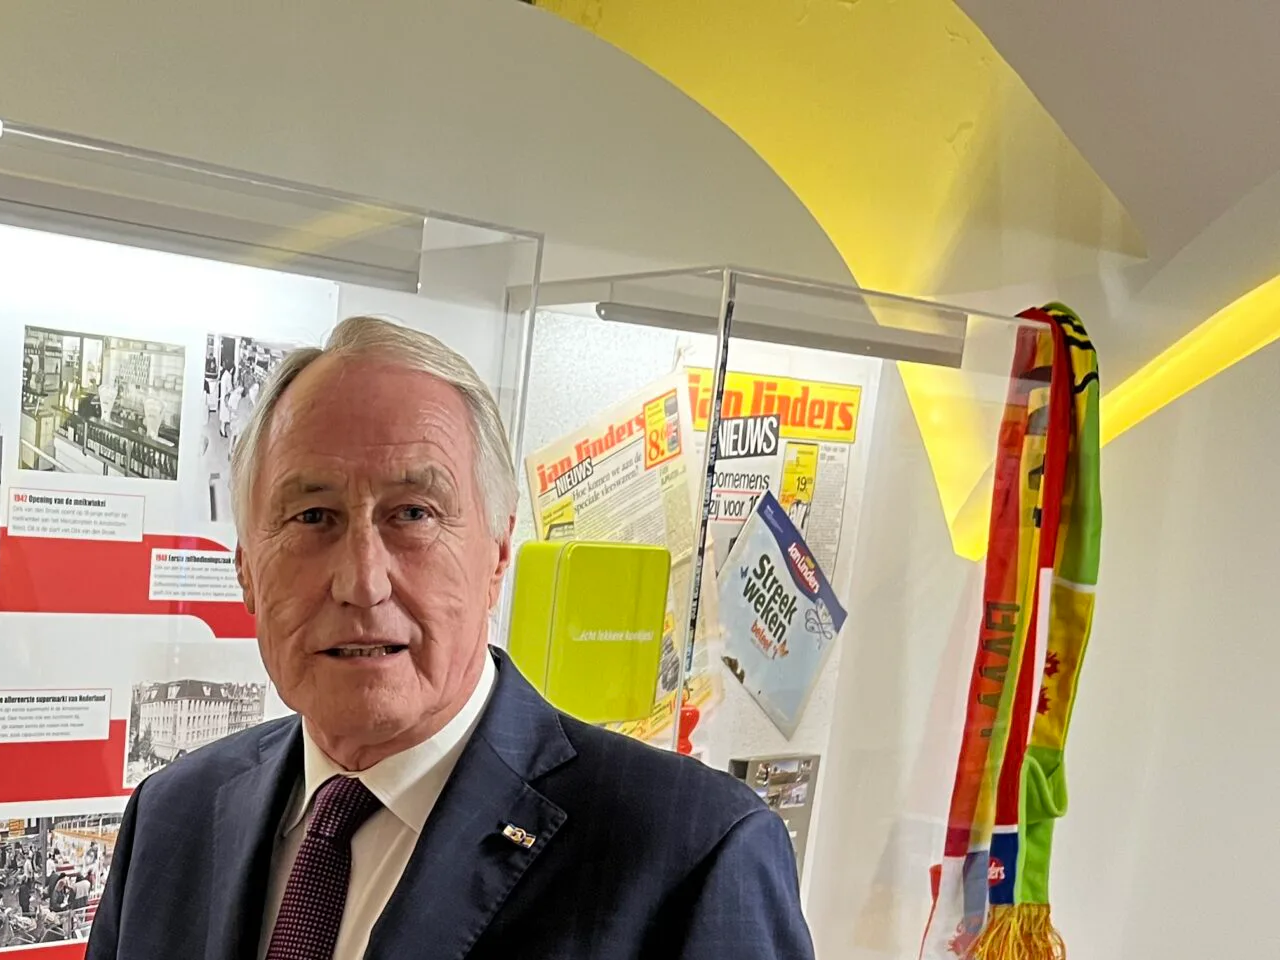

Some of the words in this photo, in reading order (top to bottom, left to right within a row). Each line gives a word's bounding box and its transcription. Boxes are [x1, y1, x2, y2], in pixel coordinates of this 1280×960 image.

[751, 380, 854, 431] linders
[536, 456, 572, 493] jan
[574, 412, 645, 462] linders
[718, 416, 778, 458] NIEUWS
[556, 458, 594, 497] NIEUWS
[712, 472, 770, 490] oornemens
[14, 493, 27, 502] 1942
[28, 494, 53, 506] Opening
[54, 496, 64, 504] van
[65, 496, 72, 505] de
[73, 497, 106, 508] melkwinkel
[724, 502, 745, 516] voor
[787, 541, 805, 566] Jan
[797, 556, 820, 593] Linders
[742, 577, 787, 643] weken
[752, 553, 798, 626] Streek
[35, 694, 67, 704] supermarkt
[78, 694, 105, 702] Nederland
